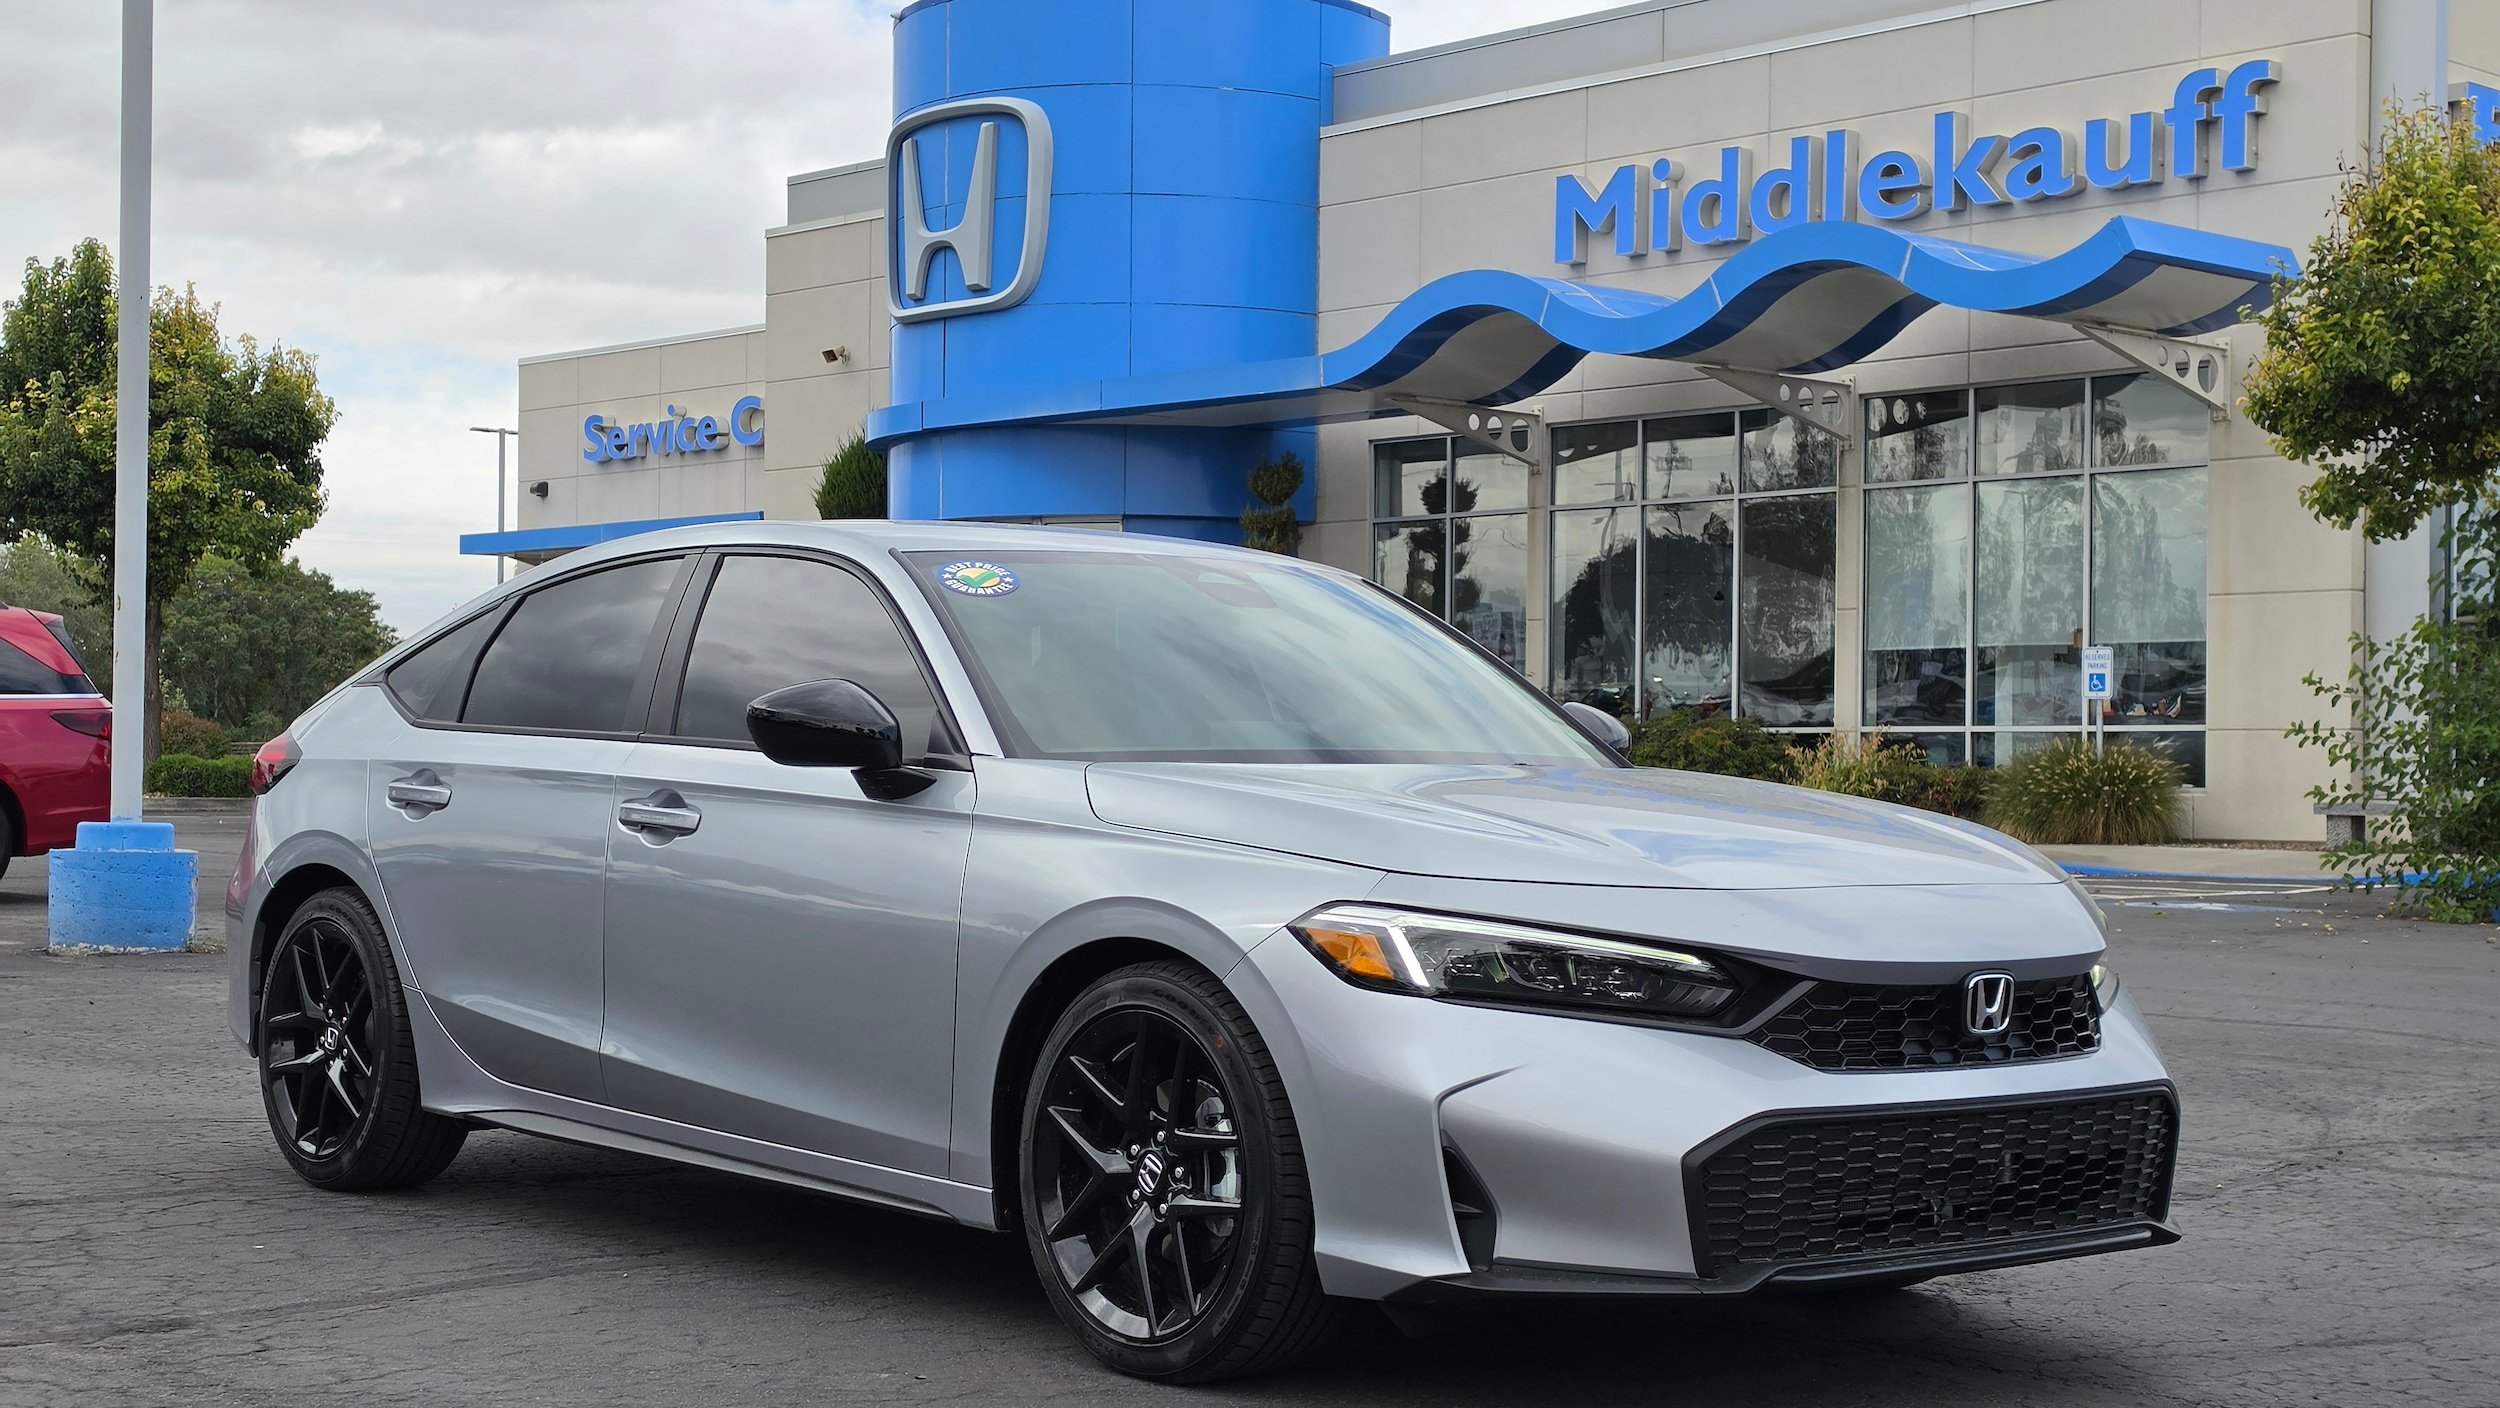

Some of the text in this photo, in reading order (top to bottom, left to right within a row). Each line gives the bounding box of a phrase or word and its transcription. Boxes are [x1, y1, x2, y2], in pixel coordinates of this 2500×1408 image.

[1554, 60, 2281, 265] Middlekauff
[583, 404, 729, 463] Service
[944, 561, 1011, 576] BEST PRICE
[2085, 653, 2111, 661] RESERVED
